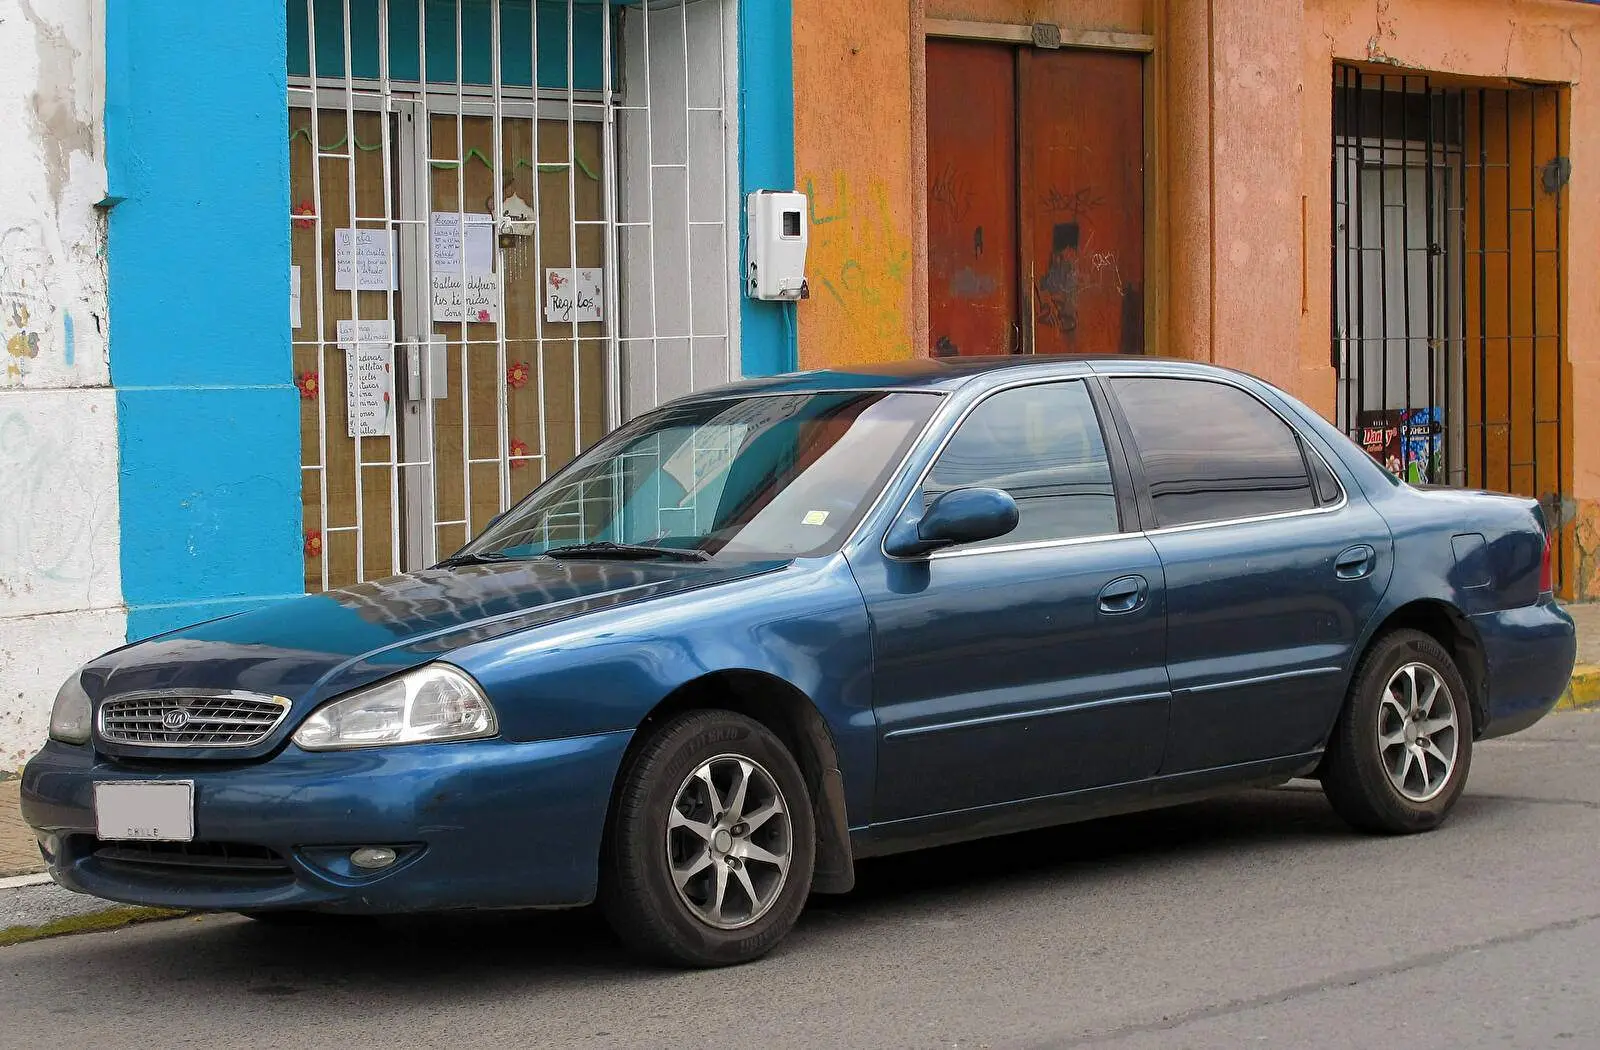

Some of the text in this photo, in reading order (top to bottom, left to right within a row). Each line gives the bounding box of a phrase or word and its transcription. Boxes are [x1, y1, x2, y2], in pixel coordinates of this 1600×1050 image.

[452, 291, 490, 306] ténicas
[550, 290, 594, 321] Reglos
[444, 307, 476, 317] Conslte
[348, 381, 379, 390] Pturas
[1363, 428, 1394, 447] Dany
[165, 713, 183, 724] KIA
[127, 828, 160, 836] CHILE
